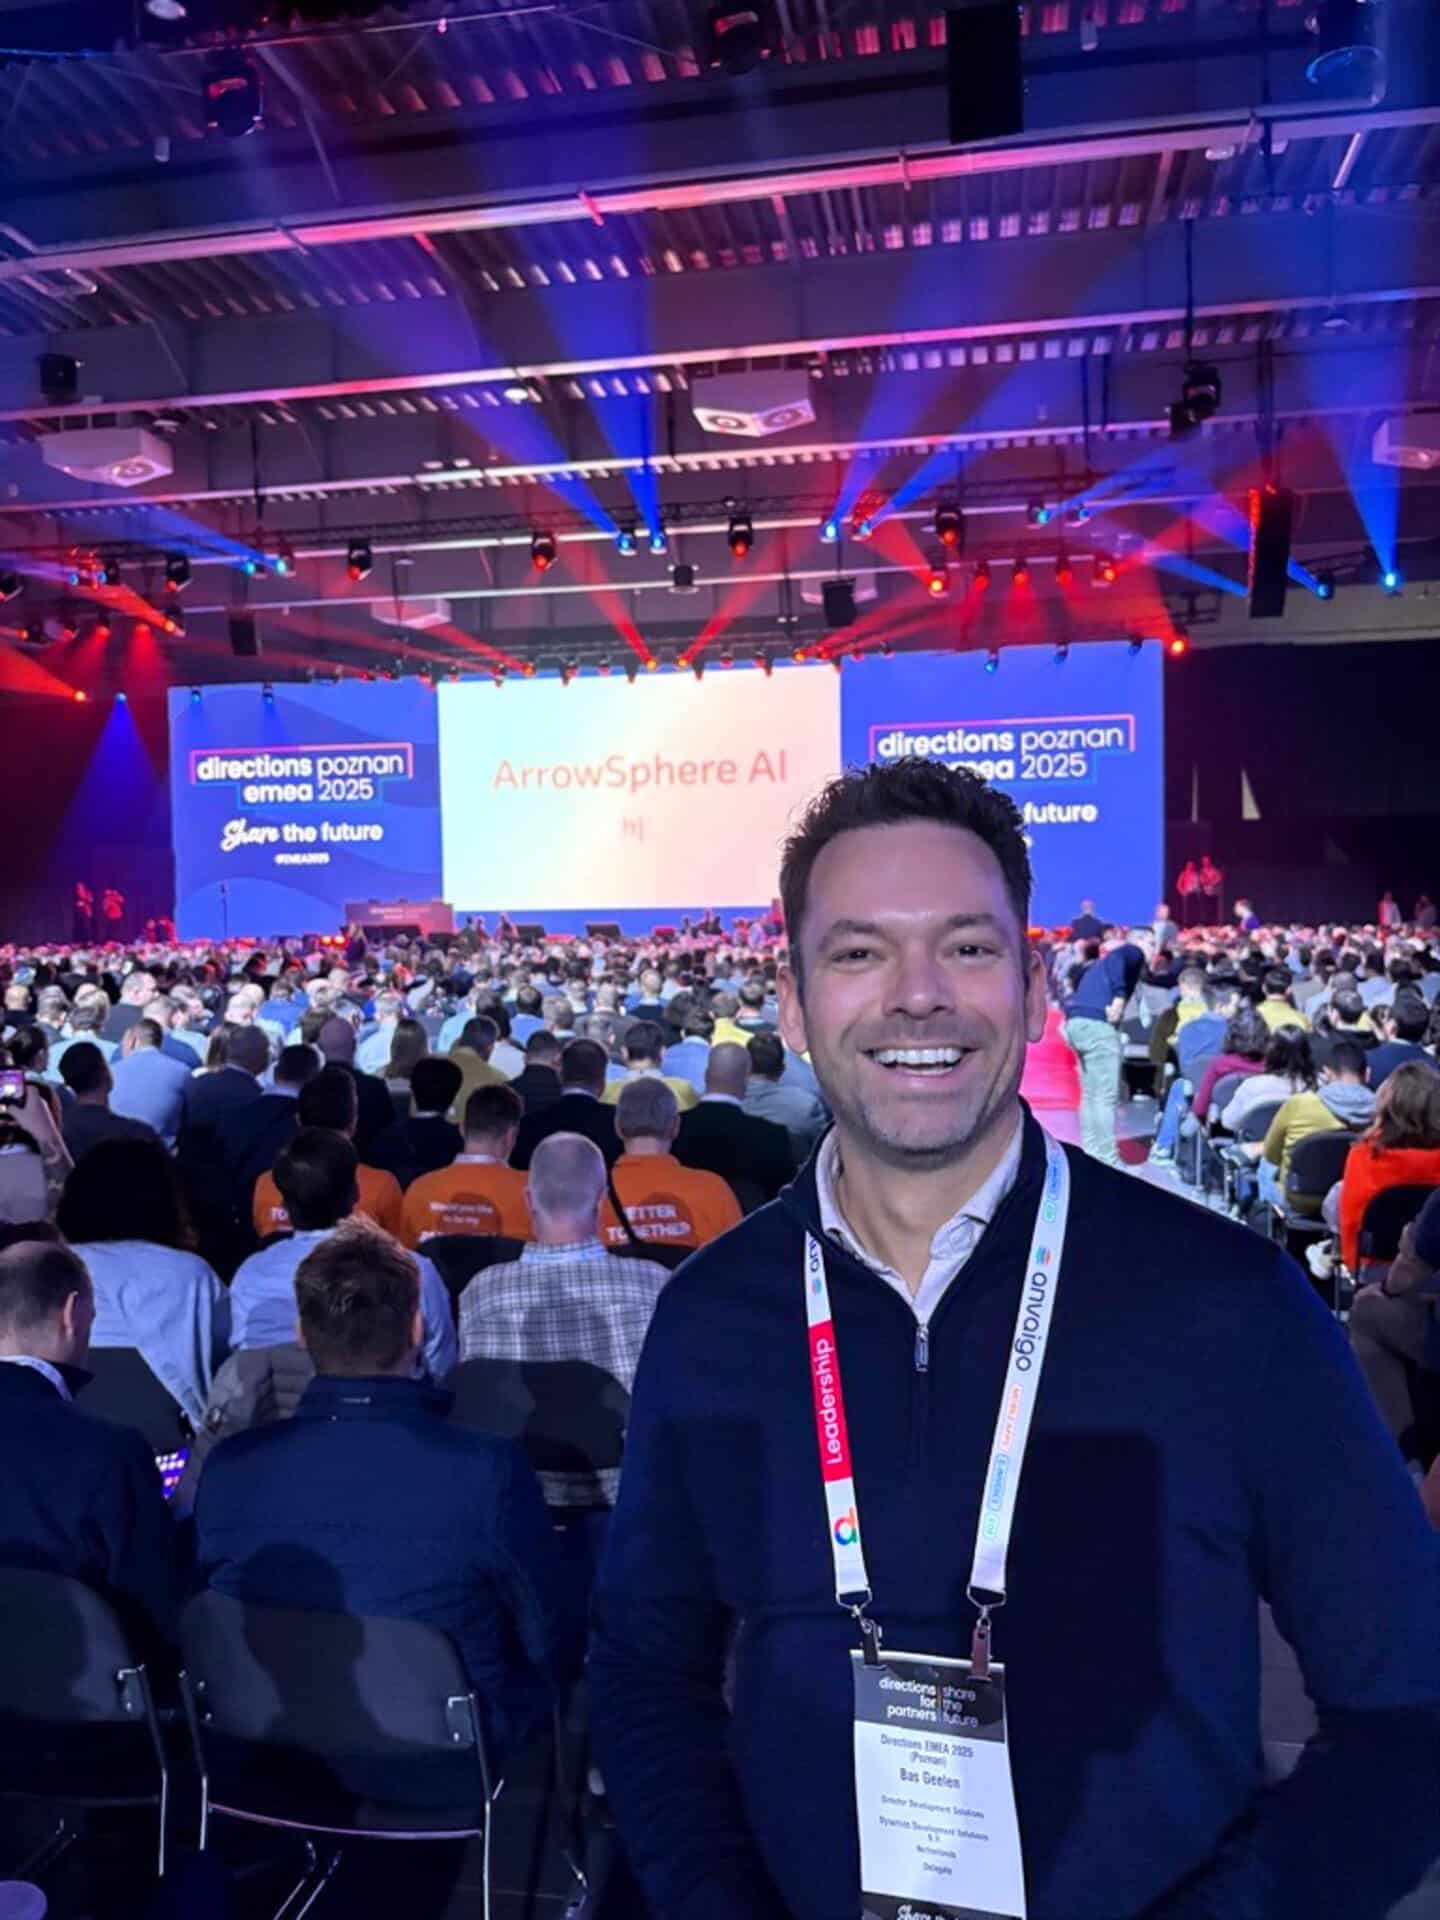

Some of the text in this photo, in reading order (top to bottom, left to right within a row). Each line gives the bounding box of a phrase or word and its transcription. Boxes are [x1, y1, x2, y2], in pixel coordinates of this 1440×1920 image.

[877, 728, 1123, 757] directions poznan
[197, 754, 403, 782] directions poznan
[494, 749, 787, 792] ArrowSphere AI
[1021, 753, 1087, 779] 2025
[244, 778, 373, 803] emea 2025
[1023, 802, 1097, 823] future
[221, 818, 383, 851] Share the future
[1014, 1272, 1047, 1372] anvaigo
[814, 1338, 843, 1465] Leadership
[879, 1676, 936, 1696] directions
[887, 1705, 936, 1722] partners
